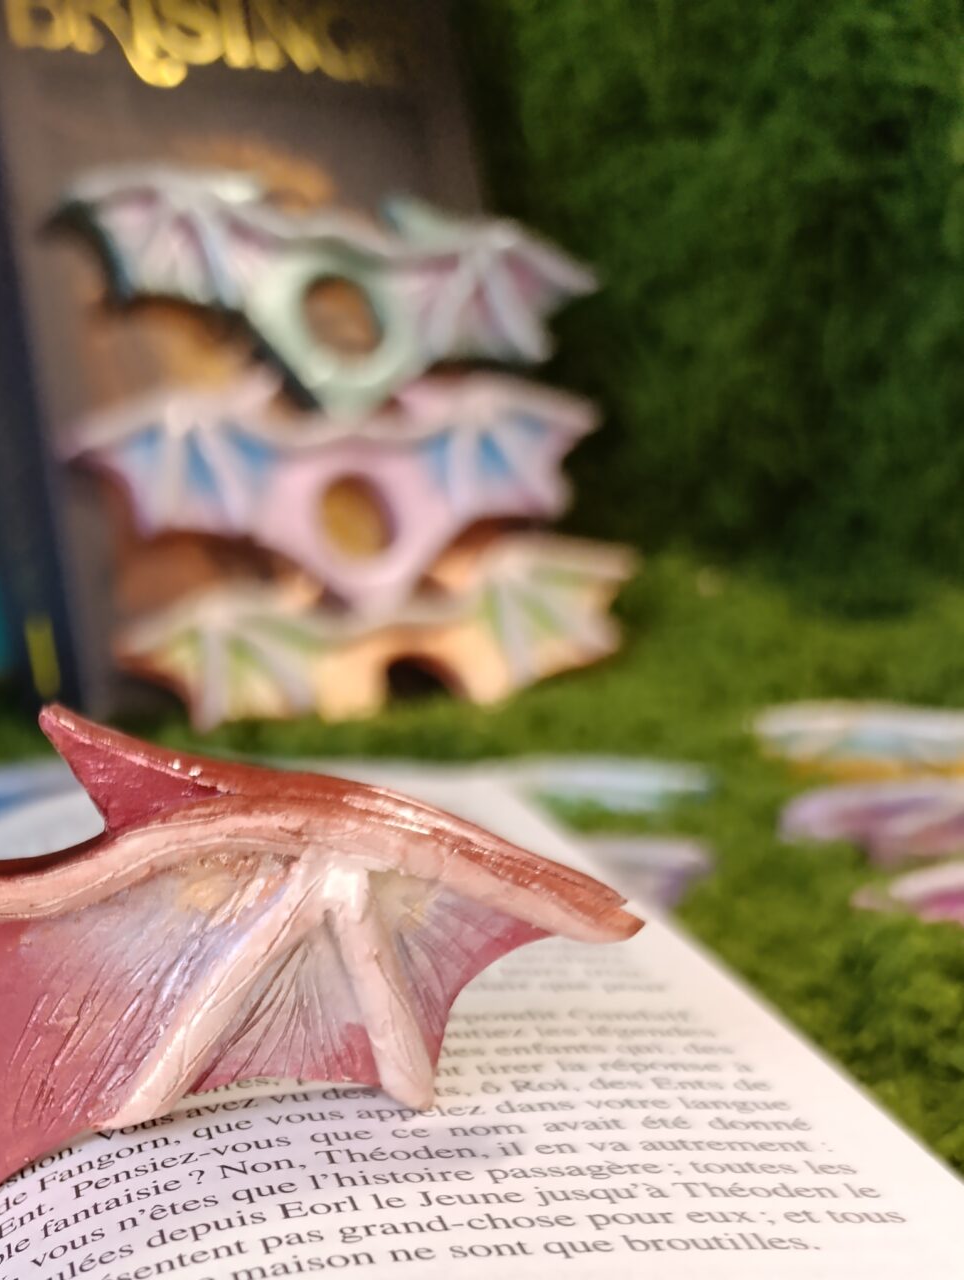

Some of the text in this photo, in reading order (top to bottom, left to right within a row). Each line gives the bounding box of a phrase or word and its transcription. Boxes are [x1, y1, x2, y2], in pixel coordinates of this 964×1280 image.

[38, 1135, 182, 1193] Fangorn,
[193, 1118, 254, 1142] que
[266, 1109, 345, 1126] vous
[495, 1100, 576, 1115] dans
[585, 1096, 672, 1111] votre
[676, 1096, 792, 1114] langue
[186, 1098, 258, 1119] avez
[40, 1177, 183, 1241] fantaisie
[218, 1157, 308, 1181] Non,
[313, 1144, 491, 1166] Théoden,
[496, 1141, 525, 1158] il
[534, 1142, 579, 1156] en
[587, 1140, 631, 1153] va
[639, 1138, 814, 1152] autrement
[71, 1135, 293, 1200] Pensiez-vous
[309, 1130, 374, 1147] que
[391, 1126, 431, 1140] ce
[448, 1122, 527, 1138] nom
[542, 1116, 627, 1133] avait
[641, 1115, 693, 1131] été
[707, 1116, 813, 1132] donné
[31, 1226, 107, 1269] vous
[117, 1193, 220, 1233] n'êtes
[231, 1180, 299, 1205] que
[307, 1166, 476, 1191] l'histoire
[485, 1159, 664, 1185] passagère
[688, 1160, 799, 1175] toutes
[803, 1159, 858, 1176] les
[145, 1209, 268, 1250] depuis
[277, 1195, 362, 1220] Eorl
[370, 1193, 407, 1210] le
[418, 1190, 526, 1208] Jeune
[533, 1181, 670, 1208] jusqu'à
[671, 1181, 841, 1199] Théoden
[843, 1182, 883, 1199] le
[259, 1227, 326, 1255] pas
[338, 1212, 578, 1244] grand-chose
[585, 1211, 675, 1231] pour
[685, 1210, 756, 1224] eux
[783, 1210, 822, 1225] et
[825, 1209, 908, 1225] tous
[388, 1245, 438, 1263] ne
[448, 1239, 536, 1259] sont
[542, 1238, 616, 1260] que
[620, 1232, 823, 1252] broutilles.
